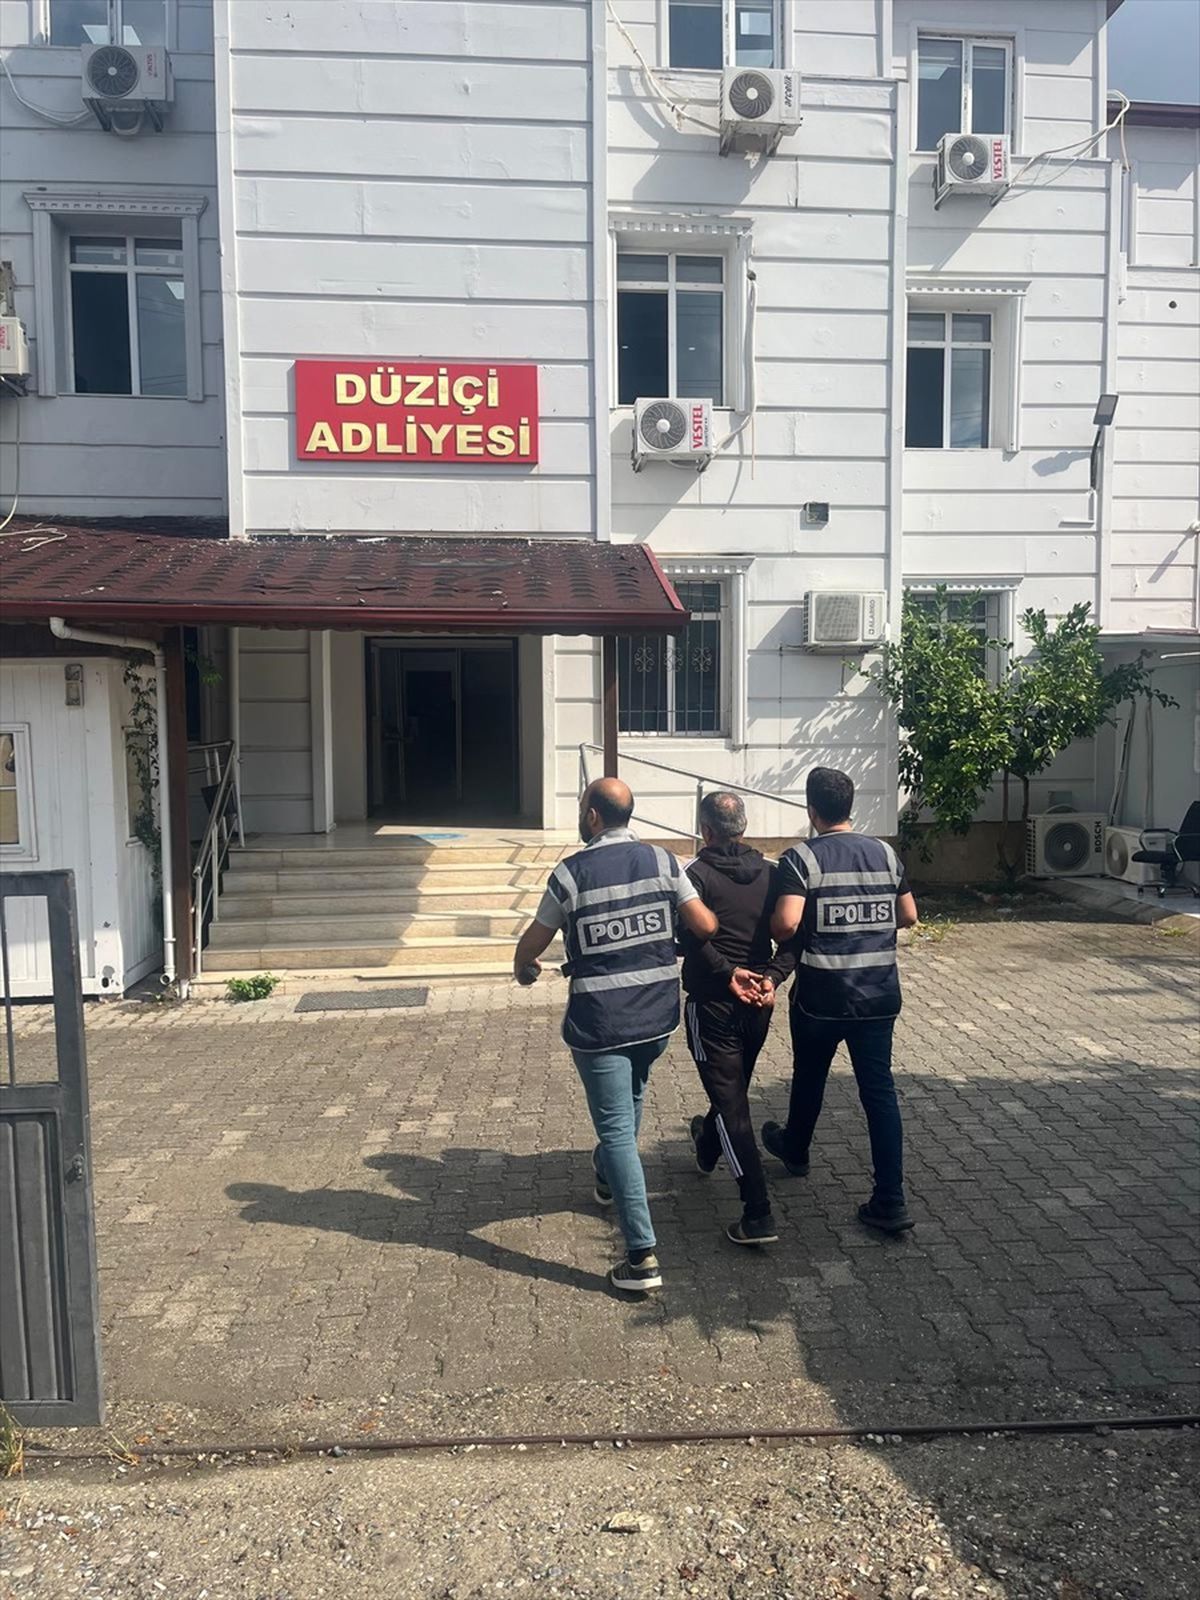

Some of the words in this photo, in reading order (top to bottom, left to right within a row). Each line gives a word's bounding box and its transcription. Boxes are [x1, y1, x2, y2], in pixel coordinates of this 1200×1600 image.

[993, 139, 1002, 179] VESTEL
[335, 366, 499, 415] DÜZİÇİ
[305, 415, 531, 456] ADLİYESİ
[692, 404, 703, 449] VESTEL
[1094, 820, 1102, 853] BOSCH
